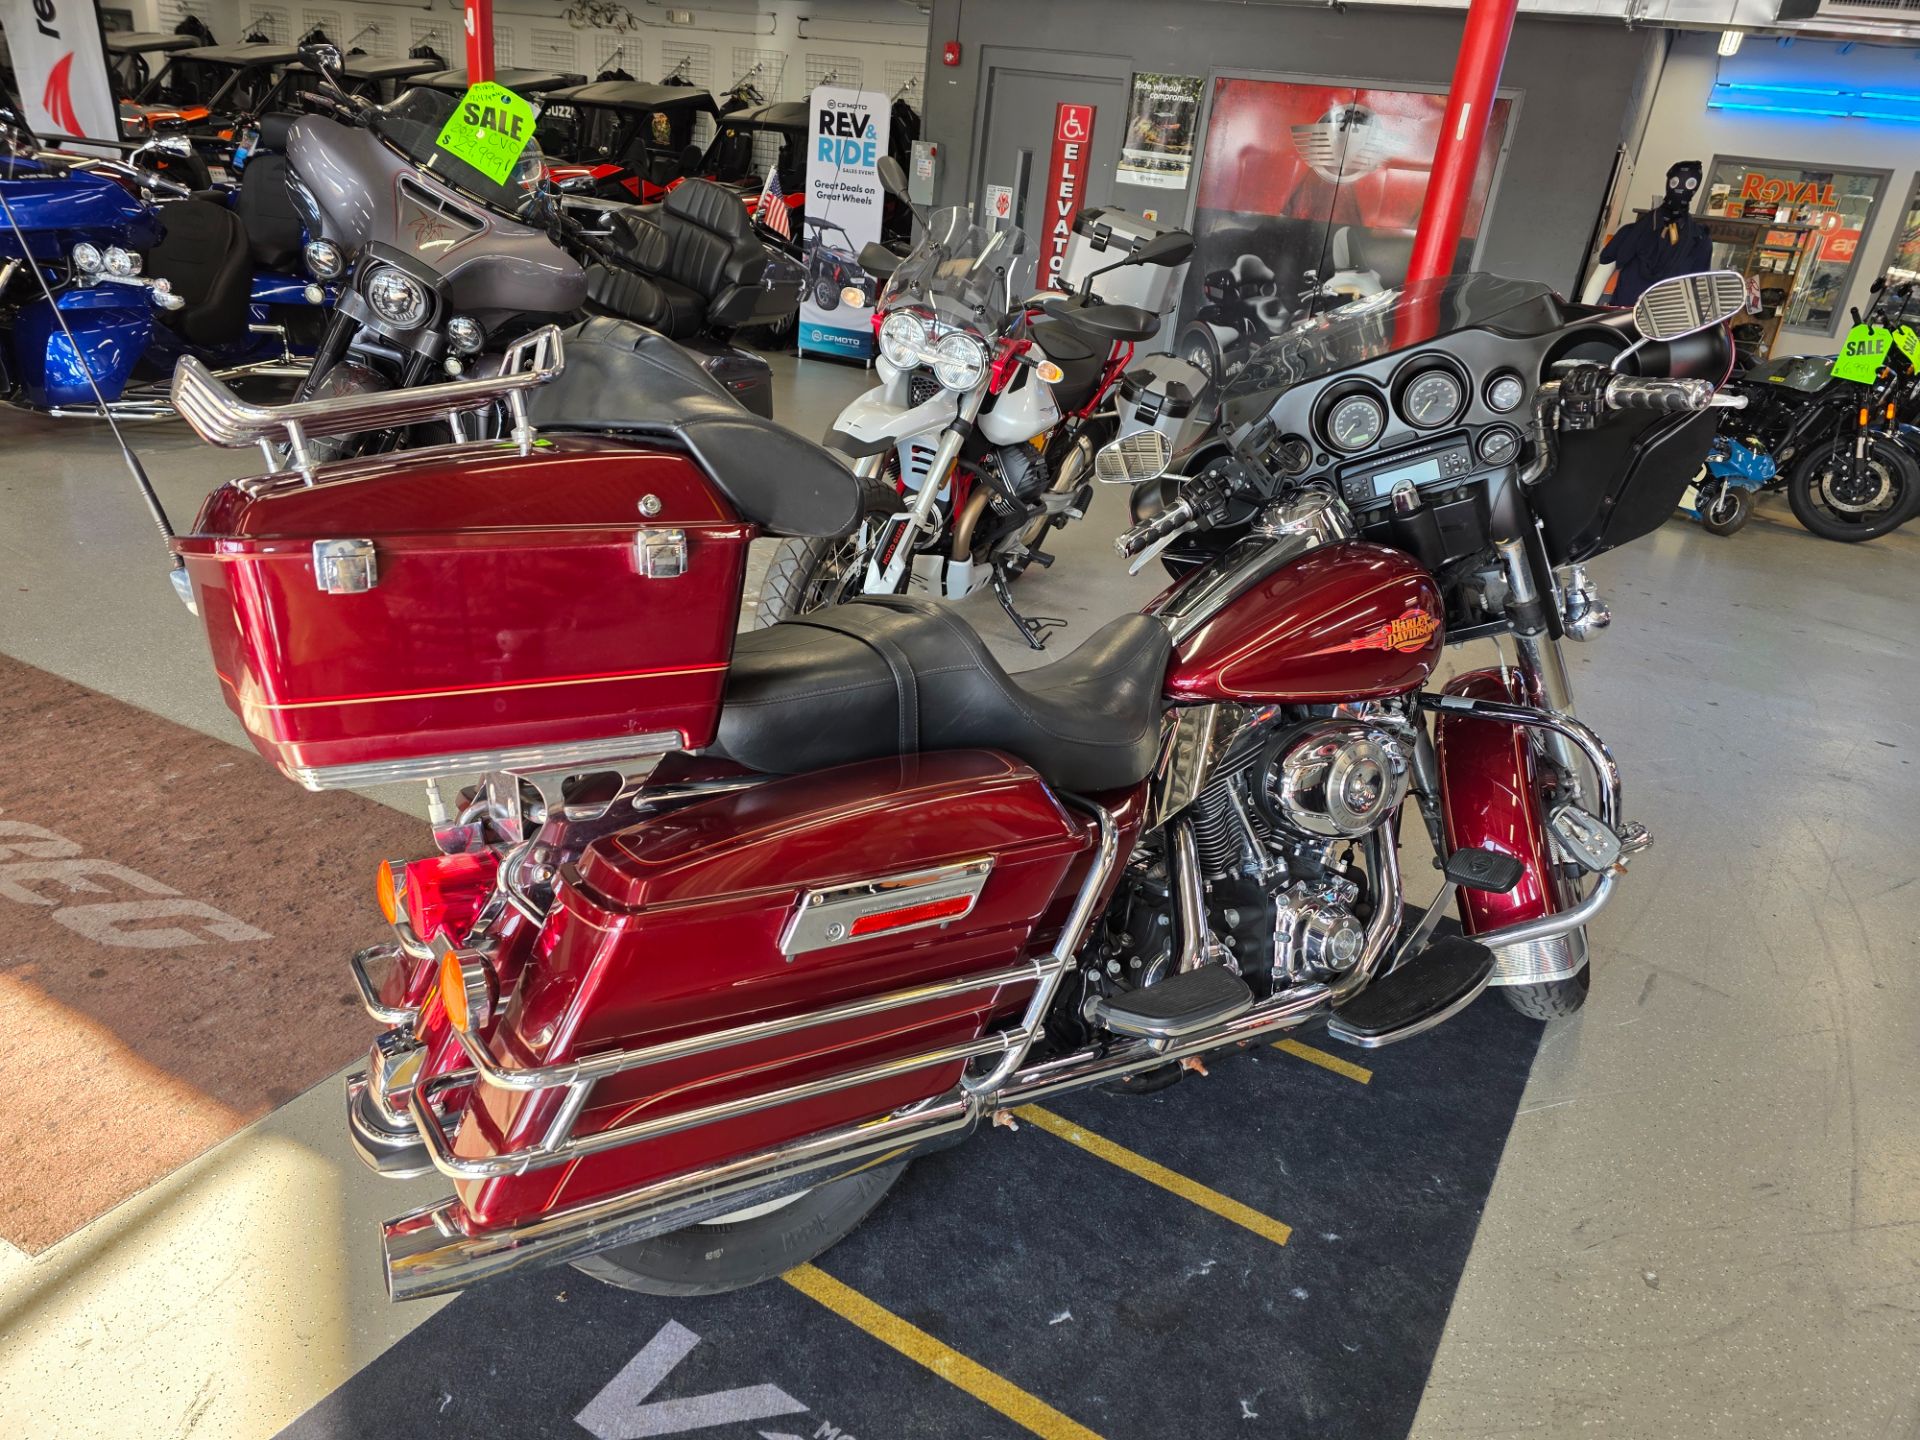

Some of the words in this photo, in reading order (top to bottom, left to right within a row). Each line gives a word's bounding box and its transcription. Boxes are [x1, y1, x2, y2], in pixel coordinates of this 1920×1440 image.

[1135, 80, 1152, 90] Ride
[1153, 83, 1182, 93] without
[837, 102, 868, 110] CFMOTO
[1149, 92, 1195, 103] compromise.
[463, 102, 524, 142] SALE
[442, 134, 451, 145] $
[818, 137, 877, 170] RIDE
[814, 179, 839, 190] Great
[840, 182, 863, 192] Deals
[864, 186, 876, 194] on
[1741, 173, 1838, 207] ROYAL
[816, 190, 841, 201] Great
[842, 193, 872, 205] Wheels
[1047, 143, 1079, 290] ELEVATOR
[823, 334, 860, 346] CFMOTO
[1846, 339, 1885, 357] SALE
[882, 543, 896, 565] MOTO
[1391, 613, 1432, 633] HARLEY
[1387, 622, 1436, 648] DAVIDSON
